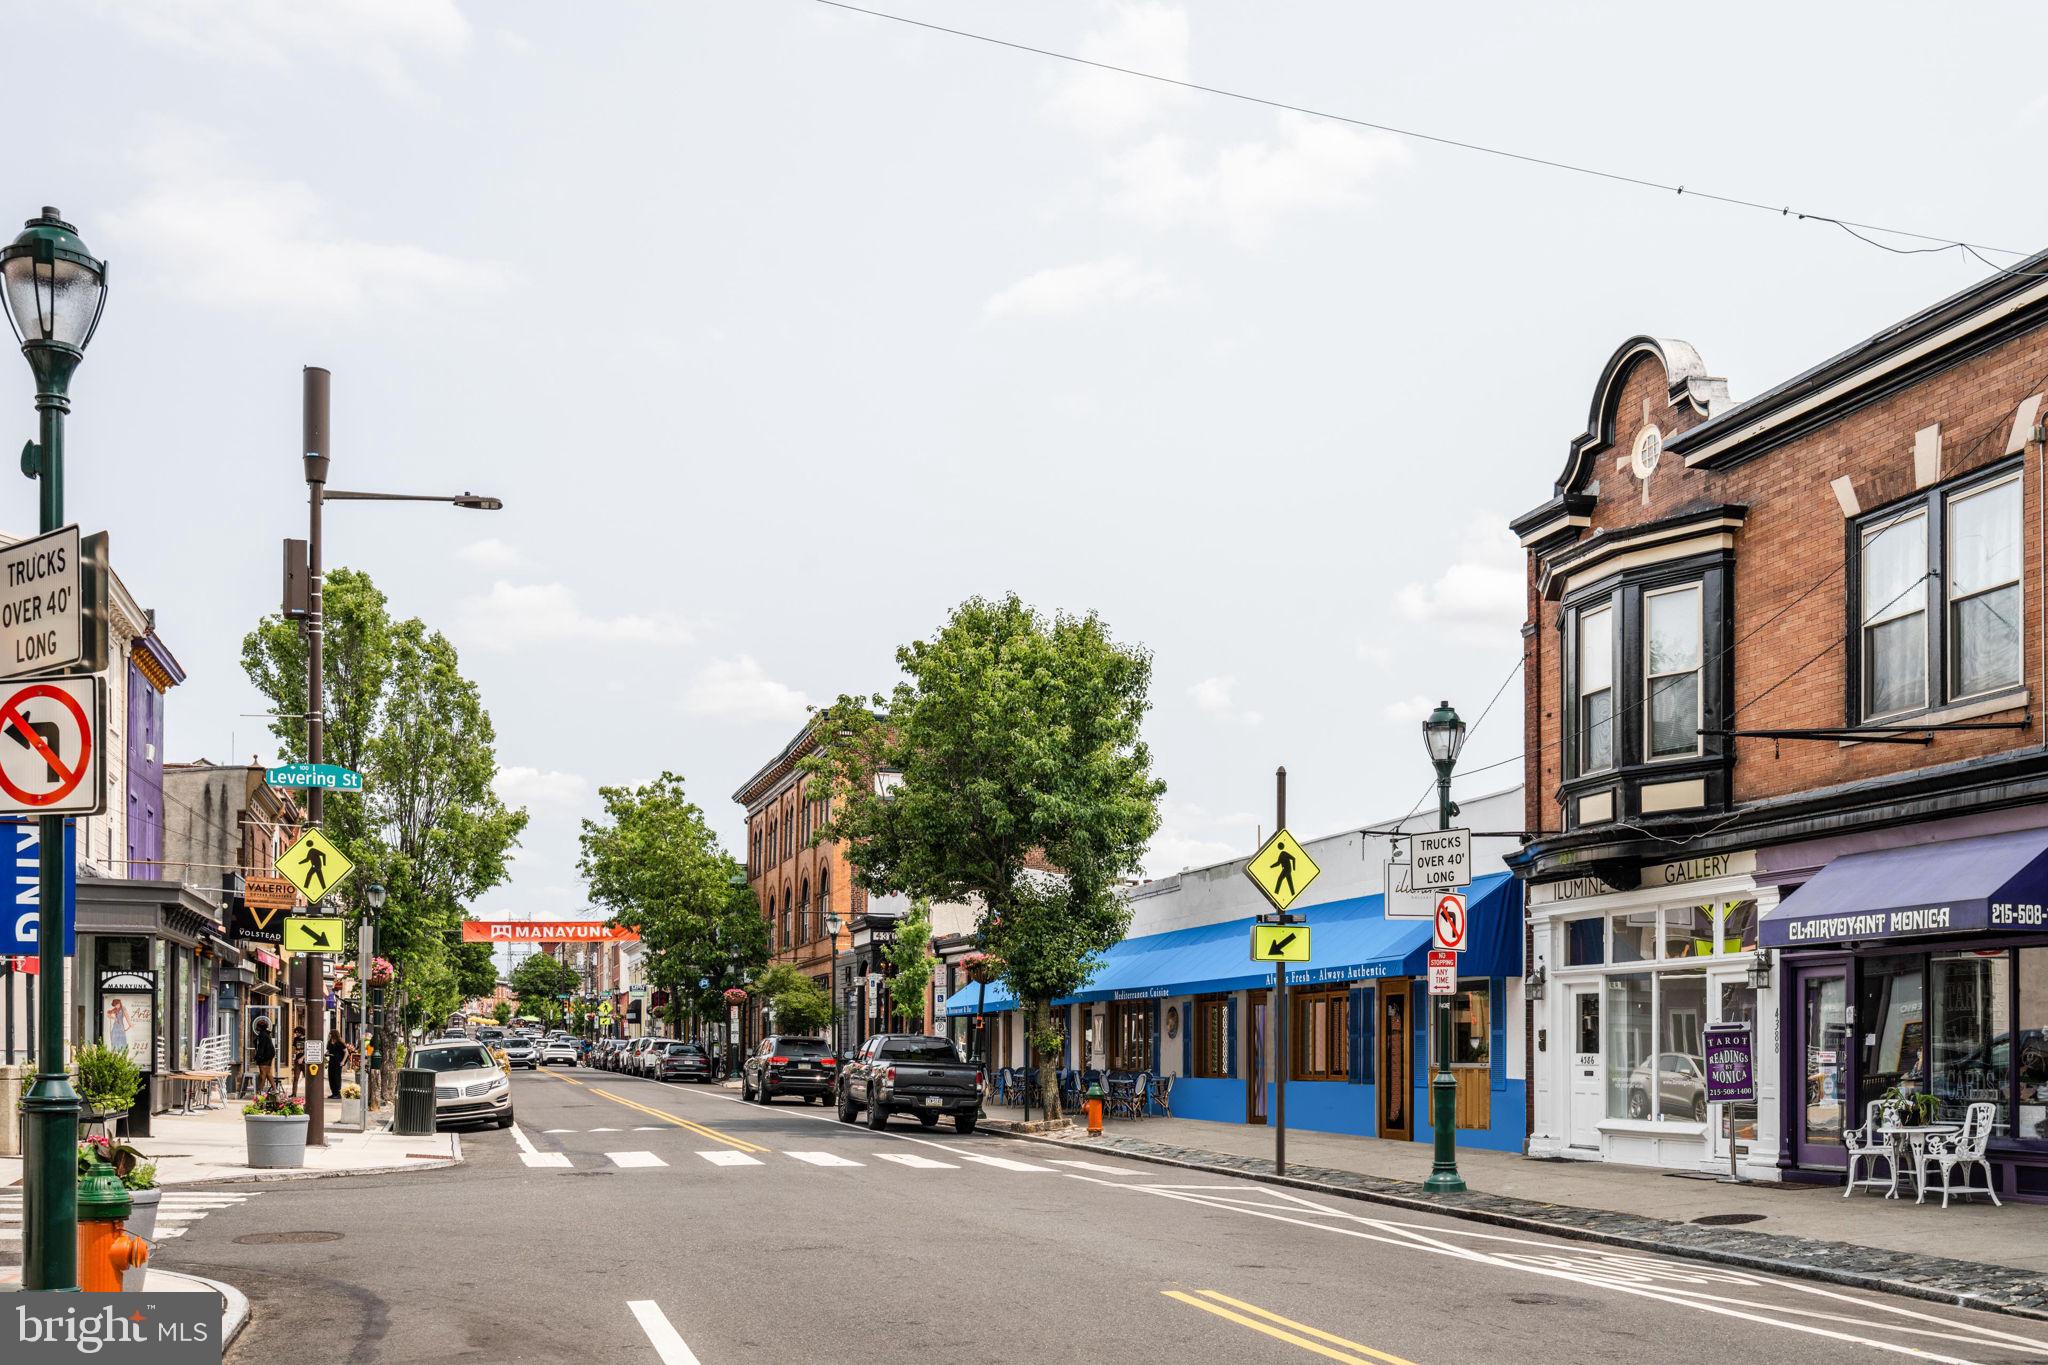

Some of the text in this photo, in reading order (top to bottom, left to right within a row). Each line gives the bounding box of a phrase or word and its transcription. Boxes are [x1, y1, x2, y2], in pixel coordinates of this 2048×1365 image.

[8, 547, 66, 587] TRUCKS
[2, 586, 71, 628] OVER 40'
[16, 630, 57, 663] LONG
[270, 770, 358, 787] Levering St
[1420, 836, 1461, 851] TRUCKS
[1417, 853, 1464, 868] OVER 40'
[1664, 854, 1730, 883] GALLERY
[1427, 870, 1454, 884] LONG
[248, 883, 296, 894] VALERIO
[1789, 904, 2048, 940] CLAIRVOYANT MONICA 215-508-
[239, 930, 282, 940] VOLSTEAD
[515, 926, 612, 938] MANAYUNK
[1291, 970, 1310, 983] Fresh
[1319, 968, 1344, 982] Always
[1348, 964, 1386, 978] Authentic
[1114, 986, 1169, 1000] Mediterranean Cuisine
[1708, 1036, 1748, 1046] TAROT
[1709, 1050, 1749, 1064] READINGS
[1712, 1070, 1747, 1084] MONICA
[1709, 1087, 1752, 1096] 215-508-1400
